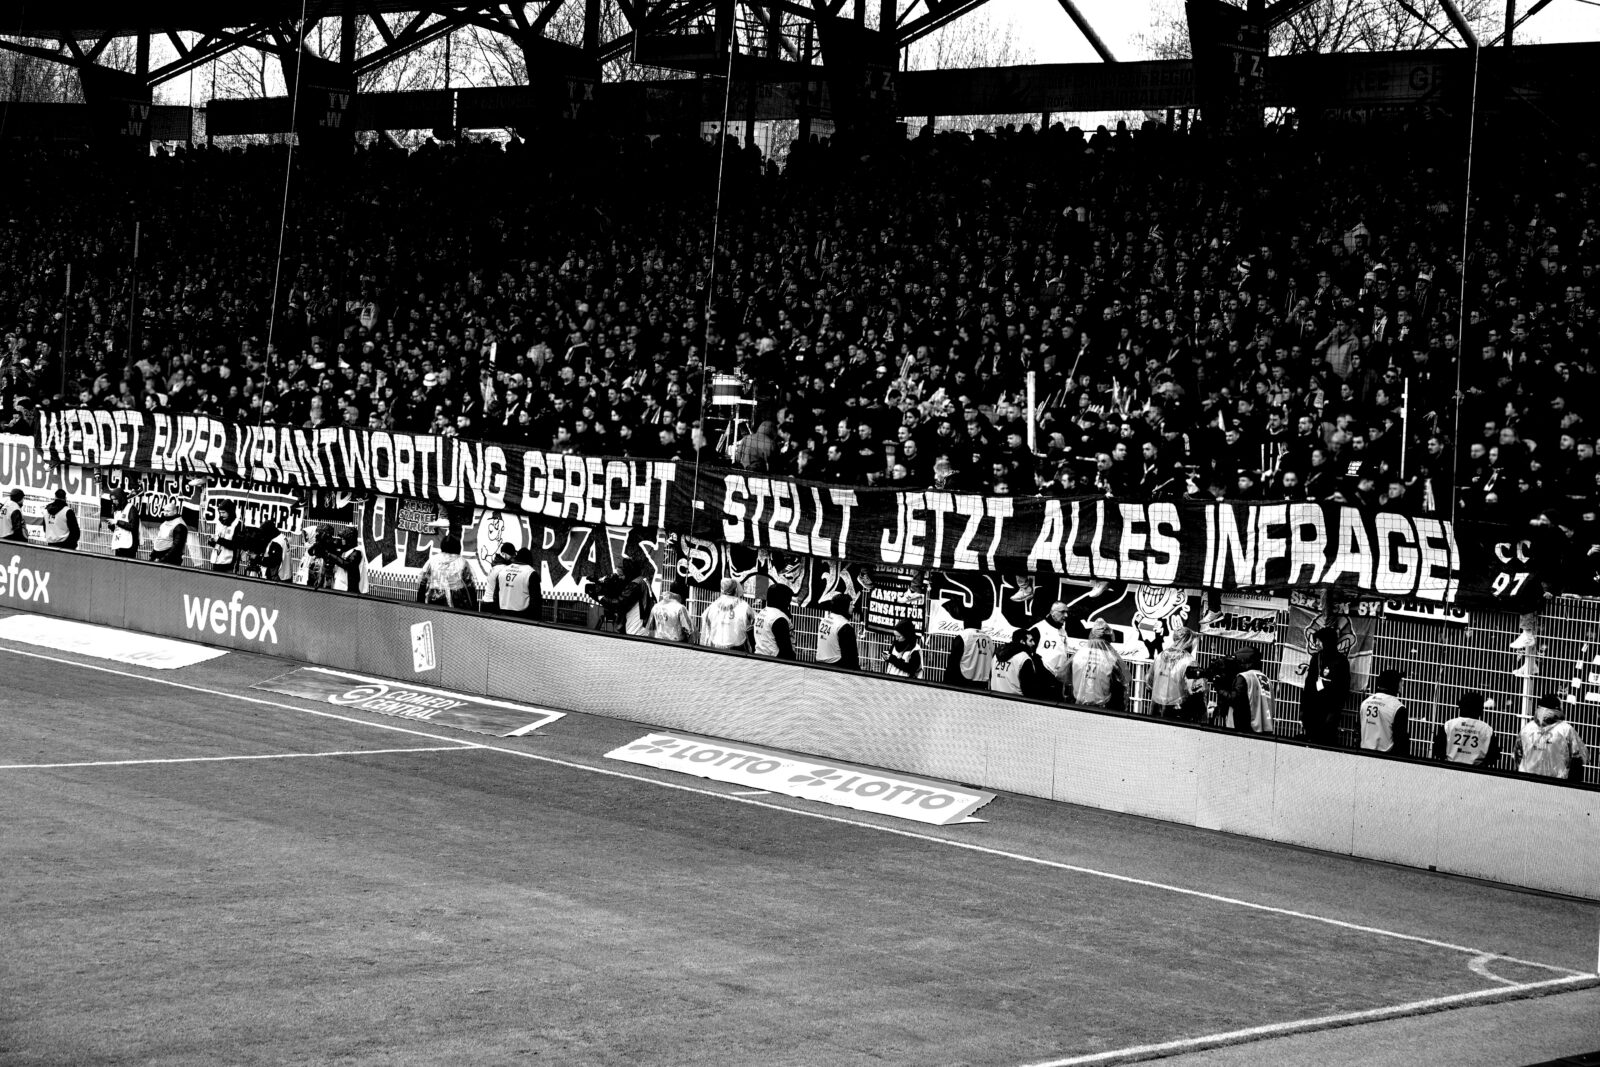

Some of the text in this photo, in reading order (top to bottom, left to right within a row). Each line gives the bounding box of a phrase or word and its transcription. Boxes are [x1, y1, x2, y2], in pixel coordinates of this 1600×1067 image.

[39, 409, 144, 468] WERDET
[150, 412, 227, 475] EURER
[234, 422, 508, 509] VERANTWORTUNG
[520, 450, 676, 529] GERECHT
[723, 474, 859, 559] STELLT
[880, 491, 1014, 571] JETZT
[1027, 499, 1181, 585] ALLES
[1202, 502, 1461, 603] INFRAGE!
[205, 498, 302, 533] STTGART
[505, 572, 517, 582] 67
[1491, 571, 1530, 597] 97
[183, 590, 279, 645] wefox
[869, 600, 907, 618] EINSATZ
[907, 605, 923, 619] FÜR
[820, 622, 832, 636] 224
[995, 660, 1011, 672] 297
[362, 698, 442, 720] CENTRAL
[385, 690, 468, 711] COMEDY
[1366, 705, 1379, 719] 53
[1453, 733, 1479, 748] 273
[670, 745, 956, 810] LOTTO LOTTO
